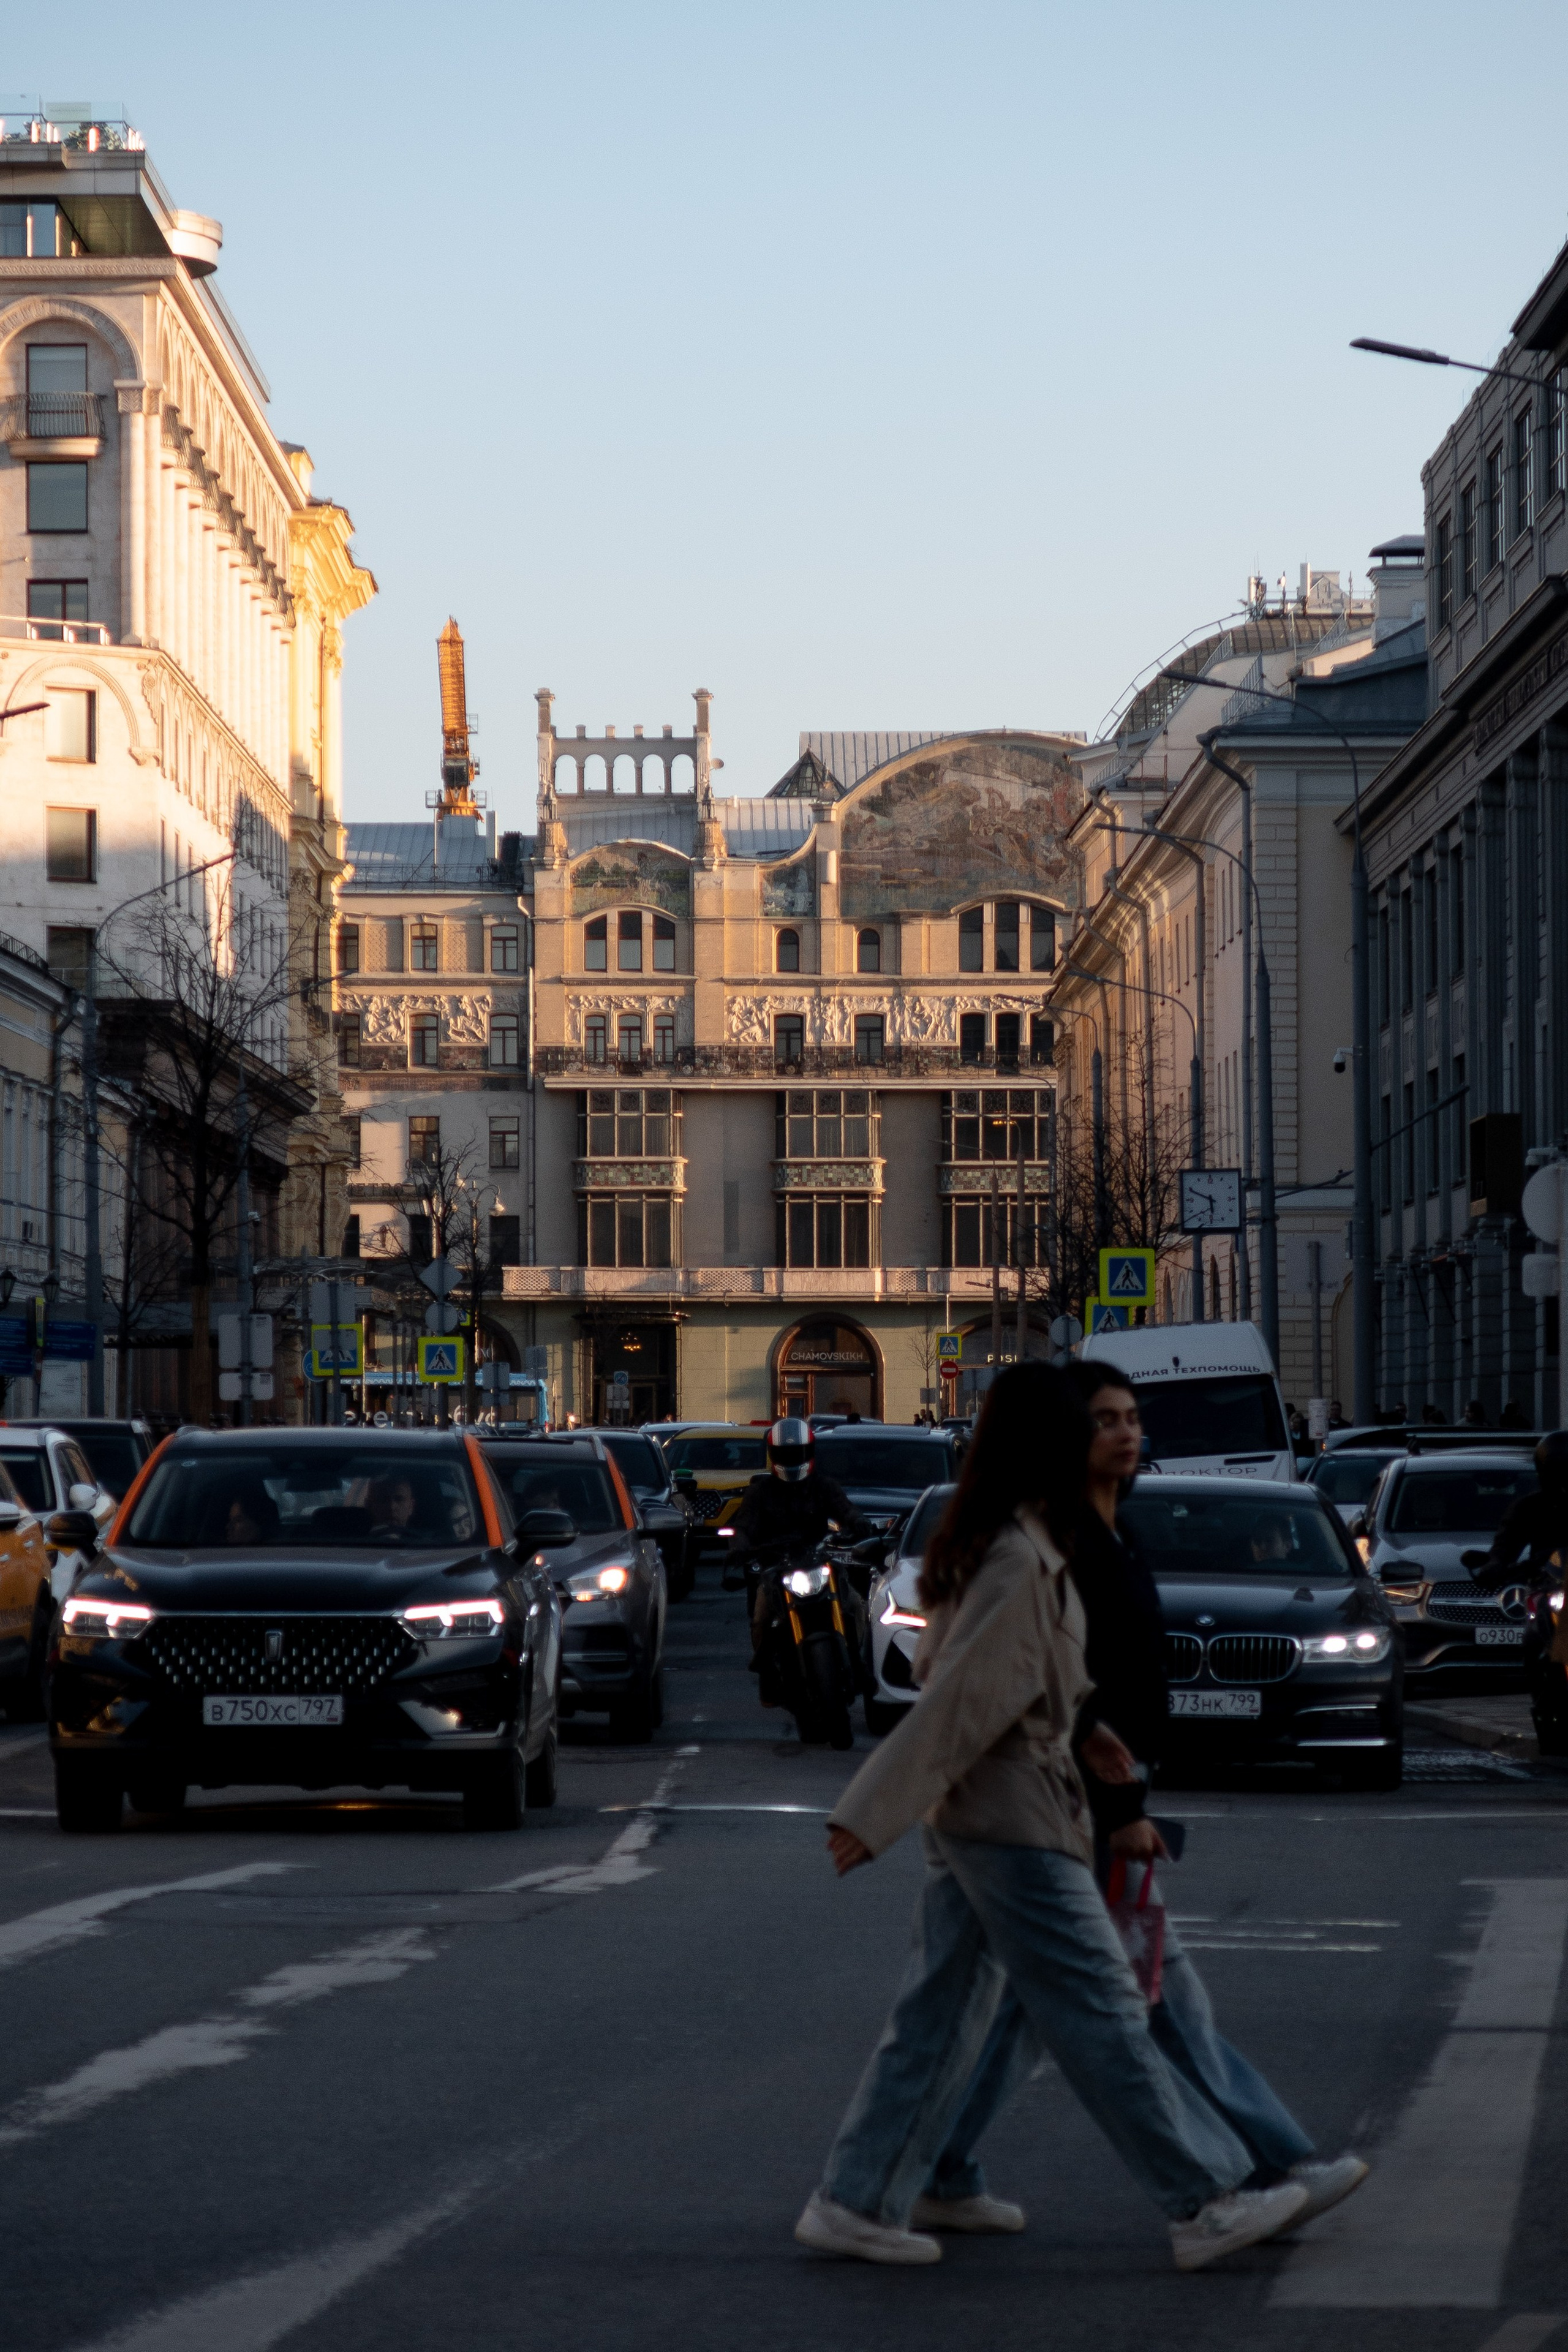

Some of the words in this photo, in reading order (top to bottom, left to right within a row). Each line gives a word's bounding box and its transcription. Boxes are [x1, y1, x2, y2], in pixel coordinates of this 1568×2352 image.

[790, 1352, 864, 1361] CHAMOVSKIKH
[1173, 1365, 1261, 1374] ТЕХПОМОЩЬ
[1229, 1694, 1255, 1708] 799
[211, 1700, 296, 1721] В750ХС
[302, 1698, 335, 1716] 797
